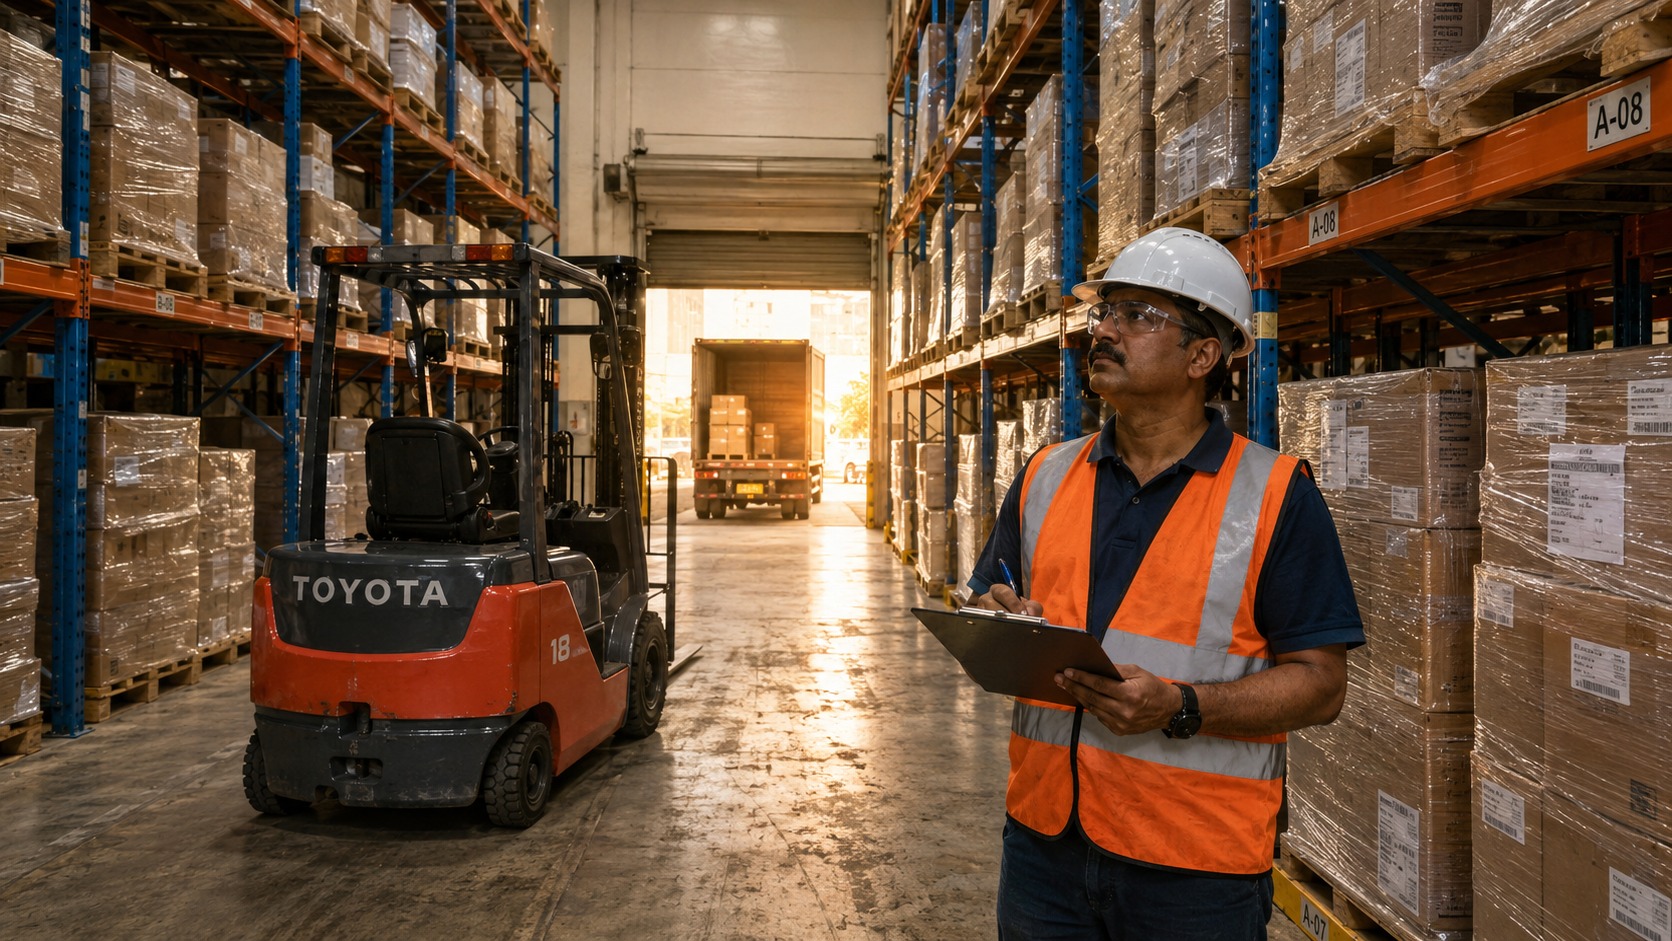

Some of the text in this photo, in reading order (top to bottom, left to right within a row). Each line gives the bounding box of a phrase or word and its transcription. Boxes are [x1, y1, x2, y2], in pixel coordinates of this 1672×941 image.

[1594, 91, 1643, 139] A-08
[1312, 210, 1336, 238] A-08
[293, 576, 449, 606] TOYOTA
[550, 634, 570, 665] 18
[1302, 904, 1327, 941] A-07
